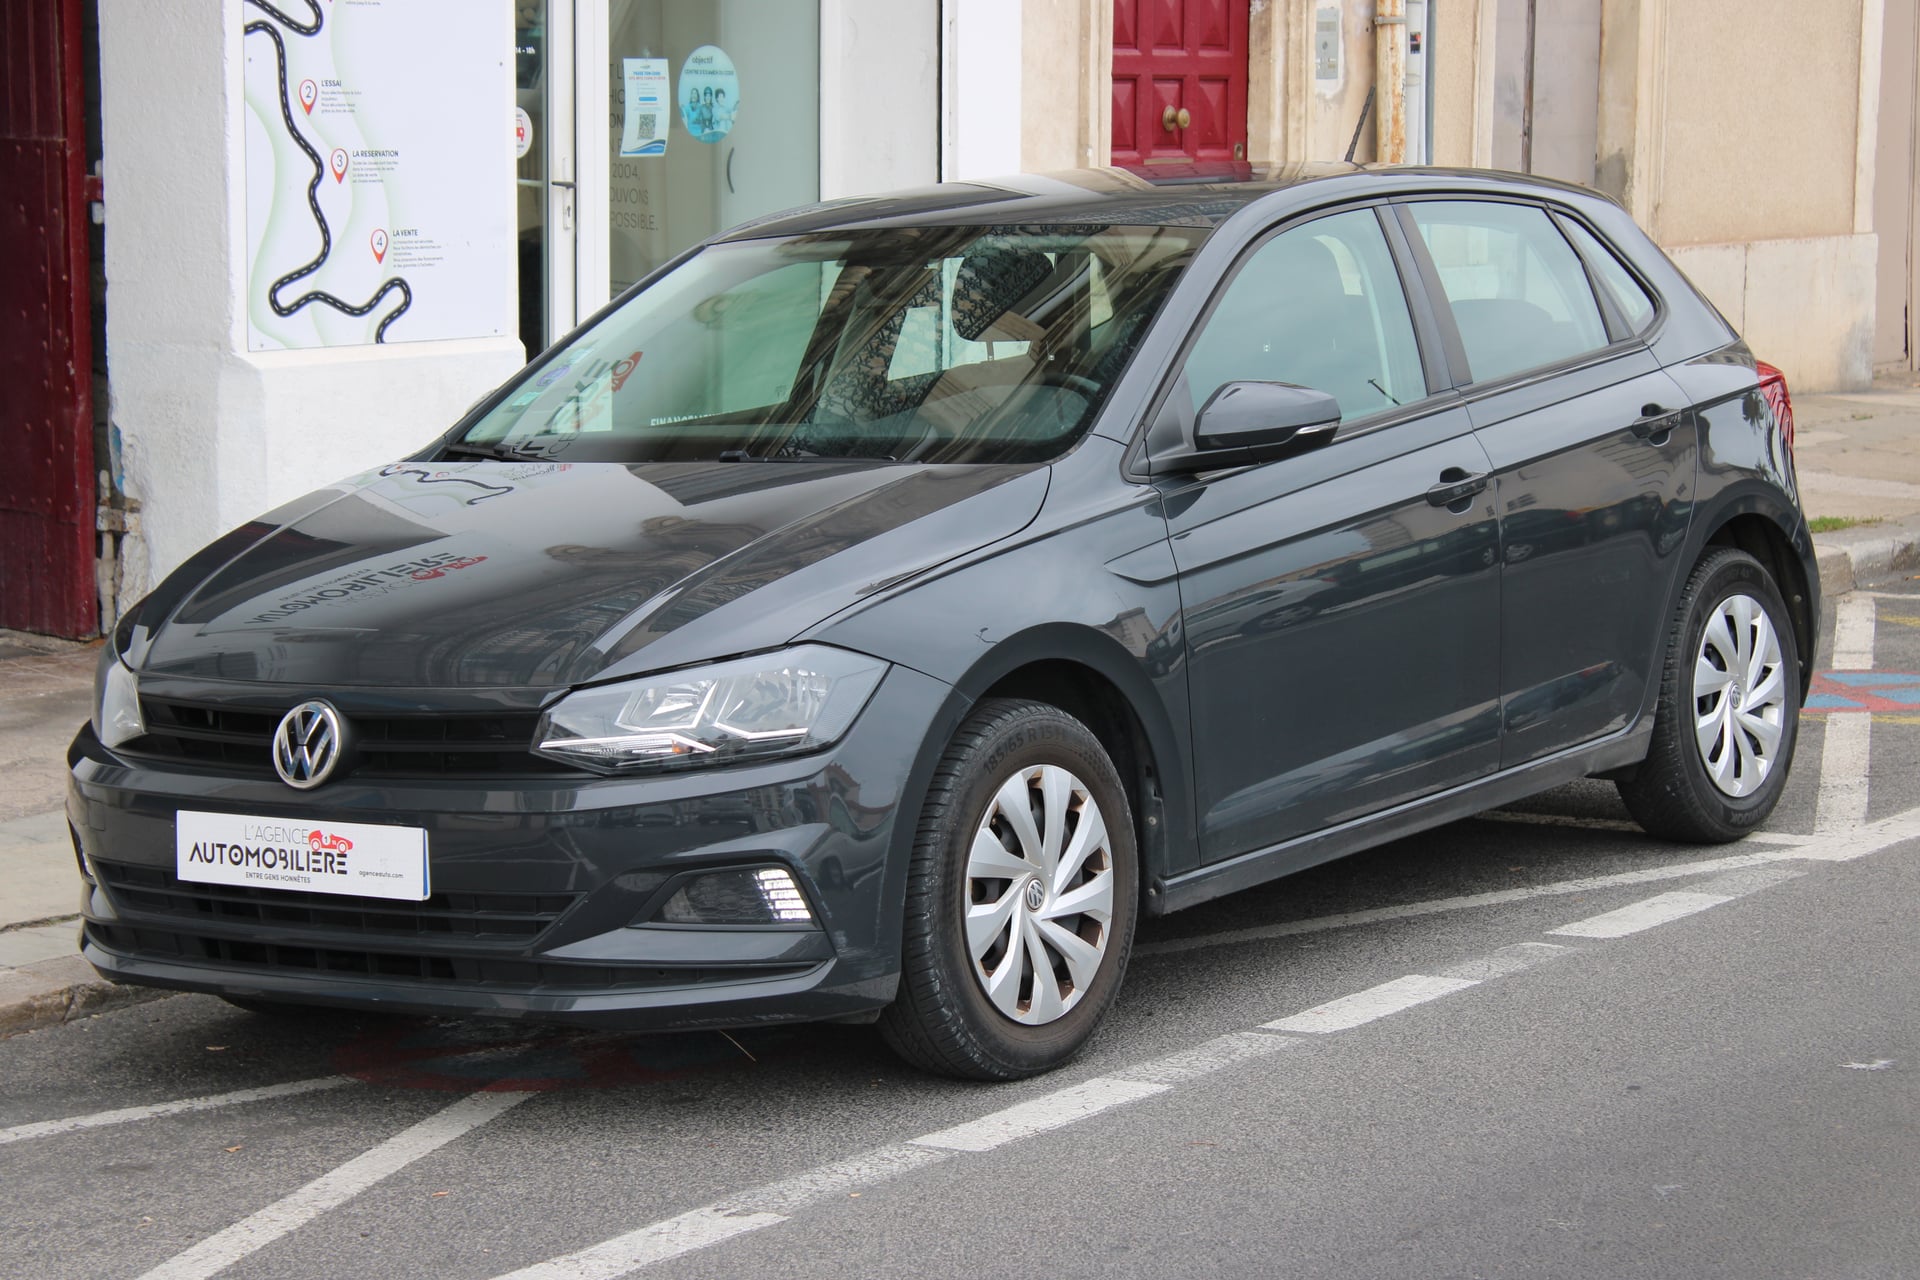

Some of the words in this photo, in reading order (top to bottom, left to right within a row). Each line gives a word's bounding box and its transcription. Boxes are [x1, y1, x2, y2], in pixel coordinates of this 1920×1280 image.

[692, 56, 713, 65] objectif
[321, 79, 342, 87] L'ESSAI
[305, 85, 312, 98] 2
[361, 149, 399, 157] RESERVATION
[336, 154, 343, 167] 3
[609, 186, 649, 206] OUVONS
[401, 229, 418, 237] VENTE
[376, 236, 383, 246] 4
[244, 824, 309, 845] L'AGENCE
[245, 872, 263, 880] ENTRE
[264, 873, 279, 881] GENS
[281, 873, 311, 884] HONNÊTES
